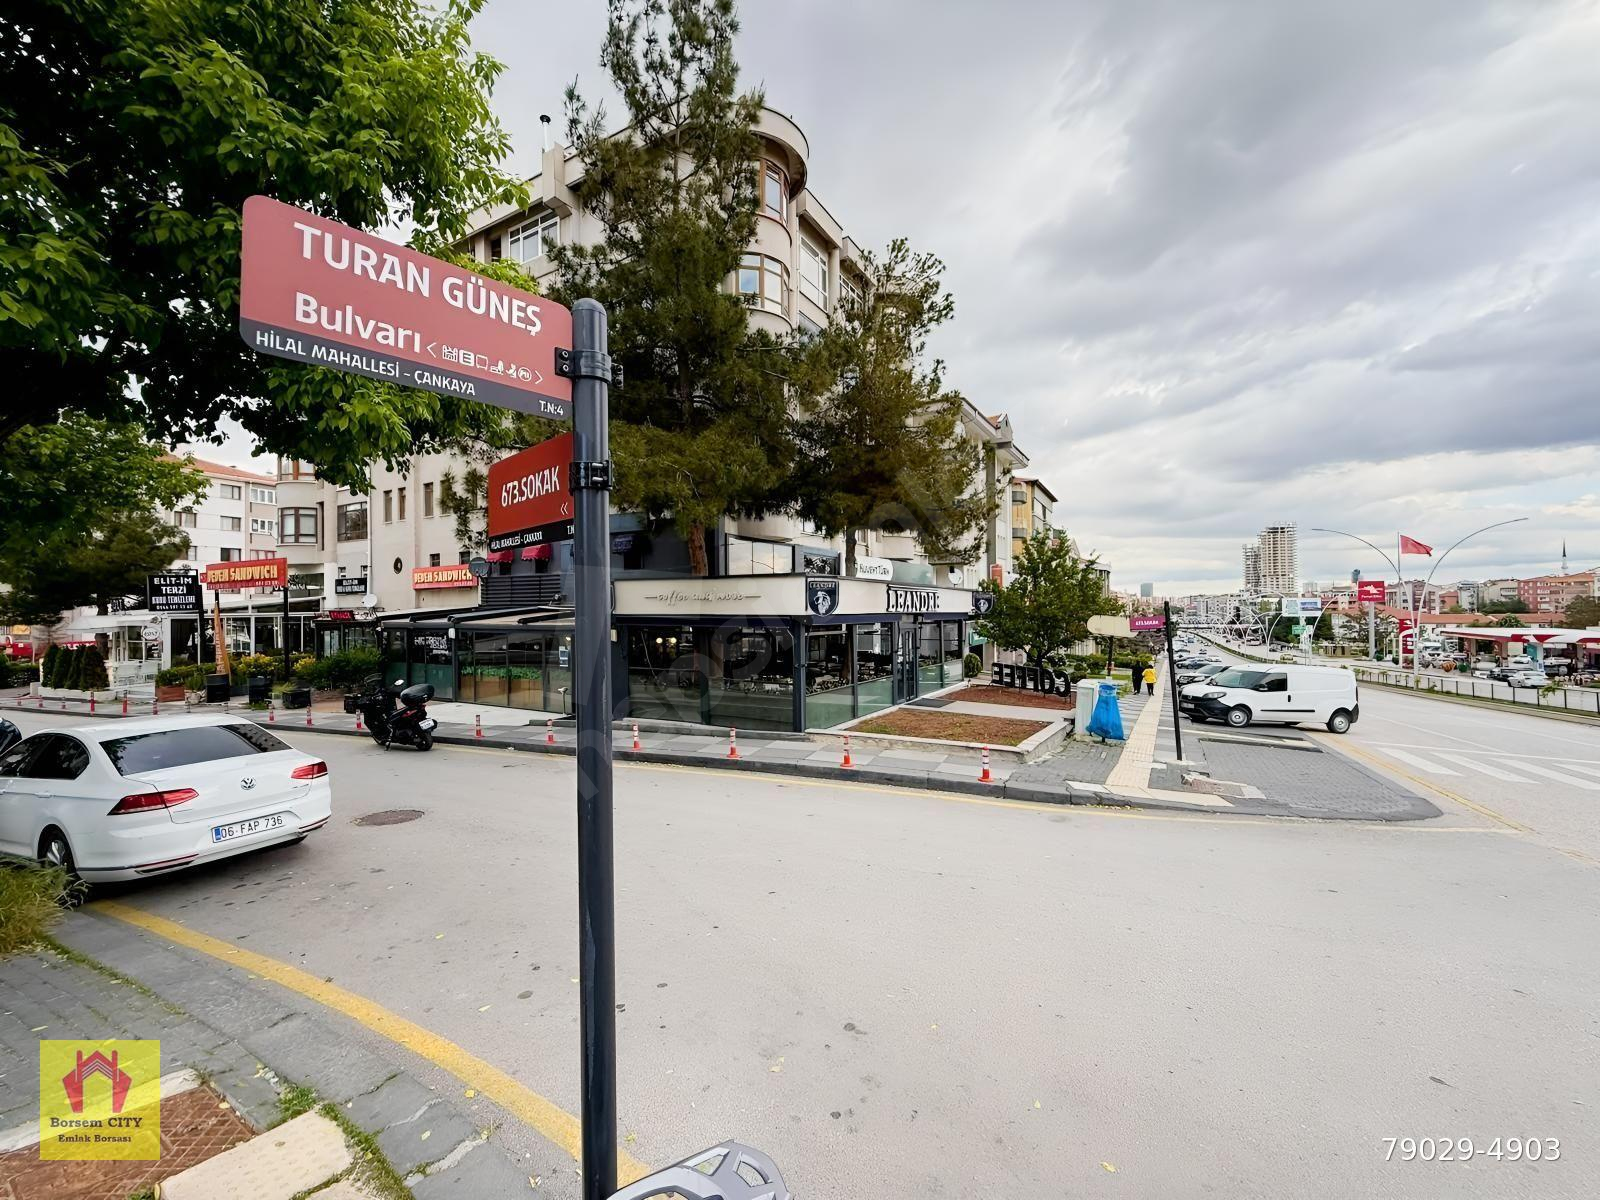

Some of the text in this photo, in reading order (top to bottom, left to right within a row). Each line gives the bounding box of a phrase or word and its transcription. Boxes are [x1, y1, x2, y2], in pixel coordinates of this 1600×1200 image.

[293, 221, 542, 337] TURAN GÜNEŞ
[295, 291, 420, 353] Bulvarı
[256, 329, 306, 356] HİLAL
[312, 345, 400, 379] MAHALLESİ
[414, 371, 476, 397] ÇANKAYA
[501, 465, 560, 508] 673.SOKAK
[230, 565, 278, 581] SANDWICH
[433, 569, 473, 582] SANDWICH
[160, 584, 187, 594] TERZİ
[887, 589, 941, 613] LEANDRE
[221, 815, 283, 839] 06 FAP 736
